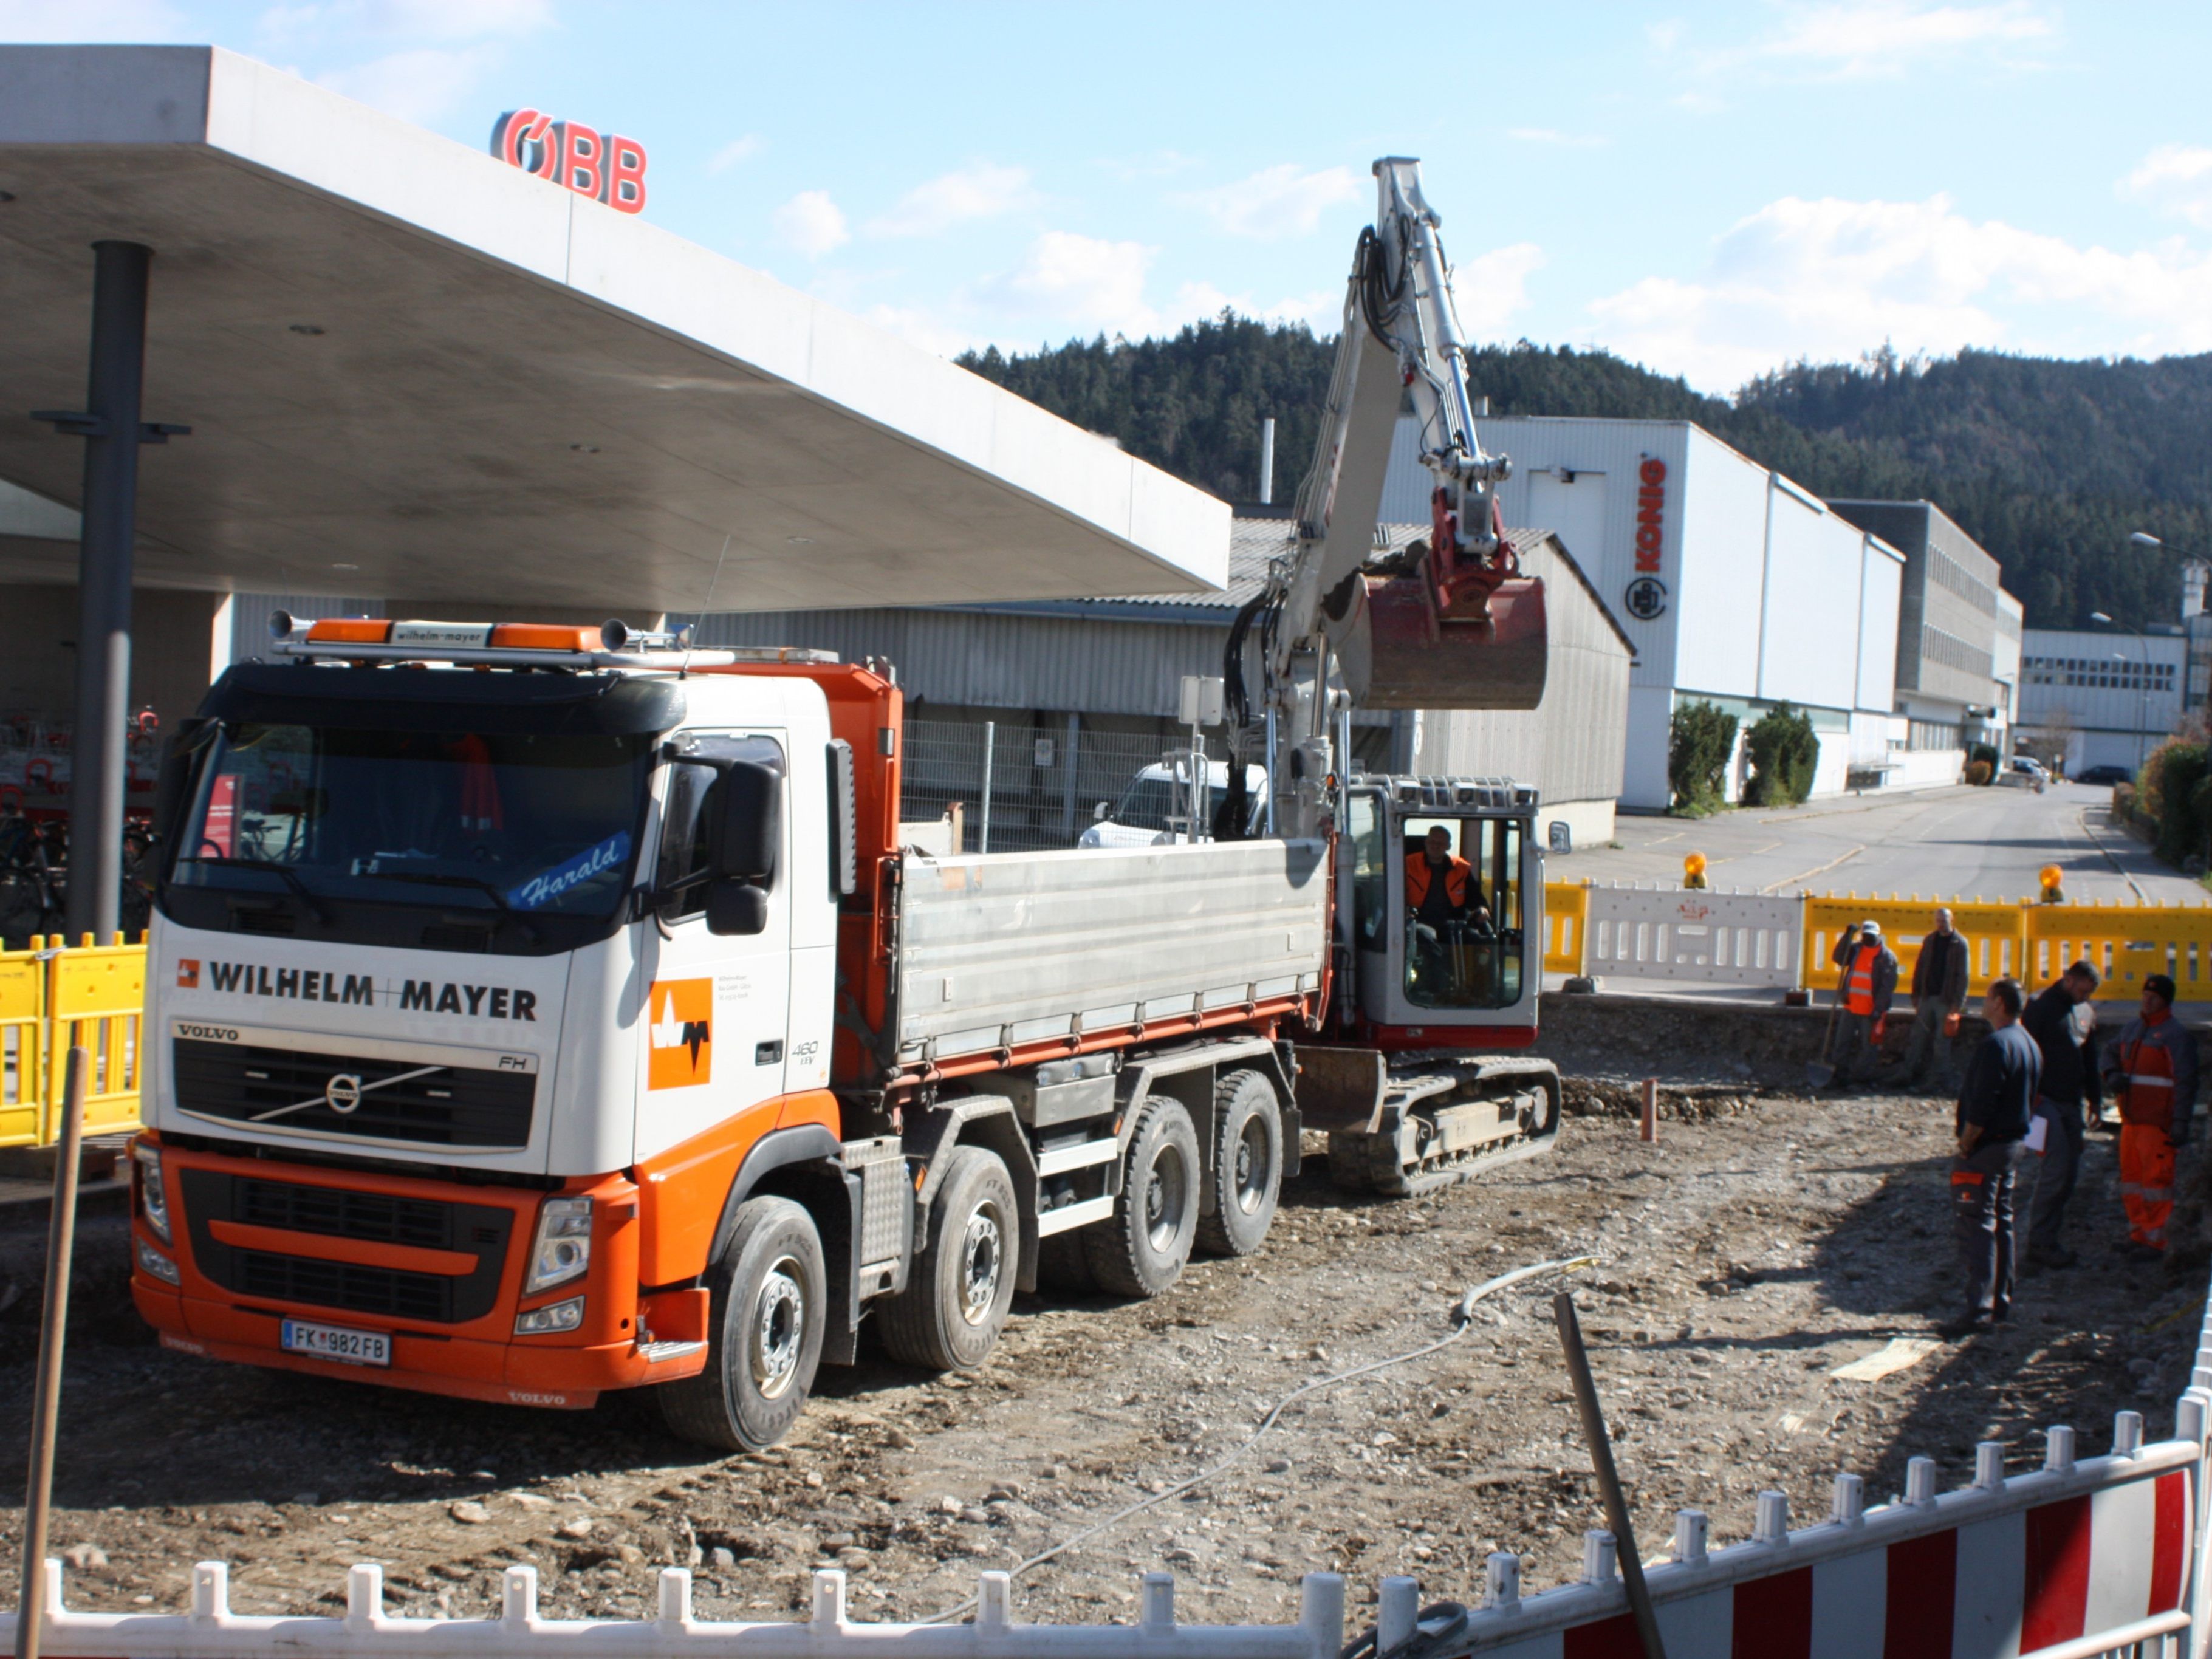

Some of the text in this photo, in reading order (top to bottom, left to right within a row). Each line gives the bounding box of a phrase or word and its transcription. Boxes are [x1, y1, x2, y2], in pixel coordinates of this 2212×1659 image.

[521, 840, 619, 906] Harald
[210, 961, 537, 1021] WILHELM MAYER
[177, 1024, 239, 1041] VOLVO
[792, 1041, 818, 1056] 460
[498, 1056, 527, 1070] FH
[296, 1327, 315, 1348] FK
[507, 1390, 566, 1405] VOLVO
